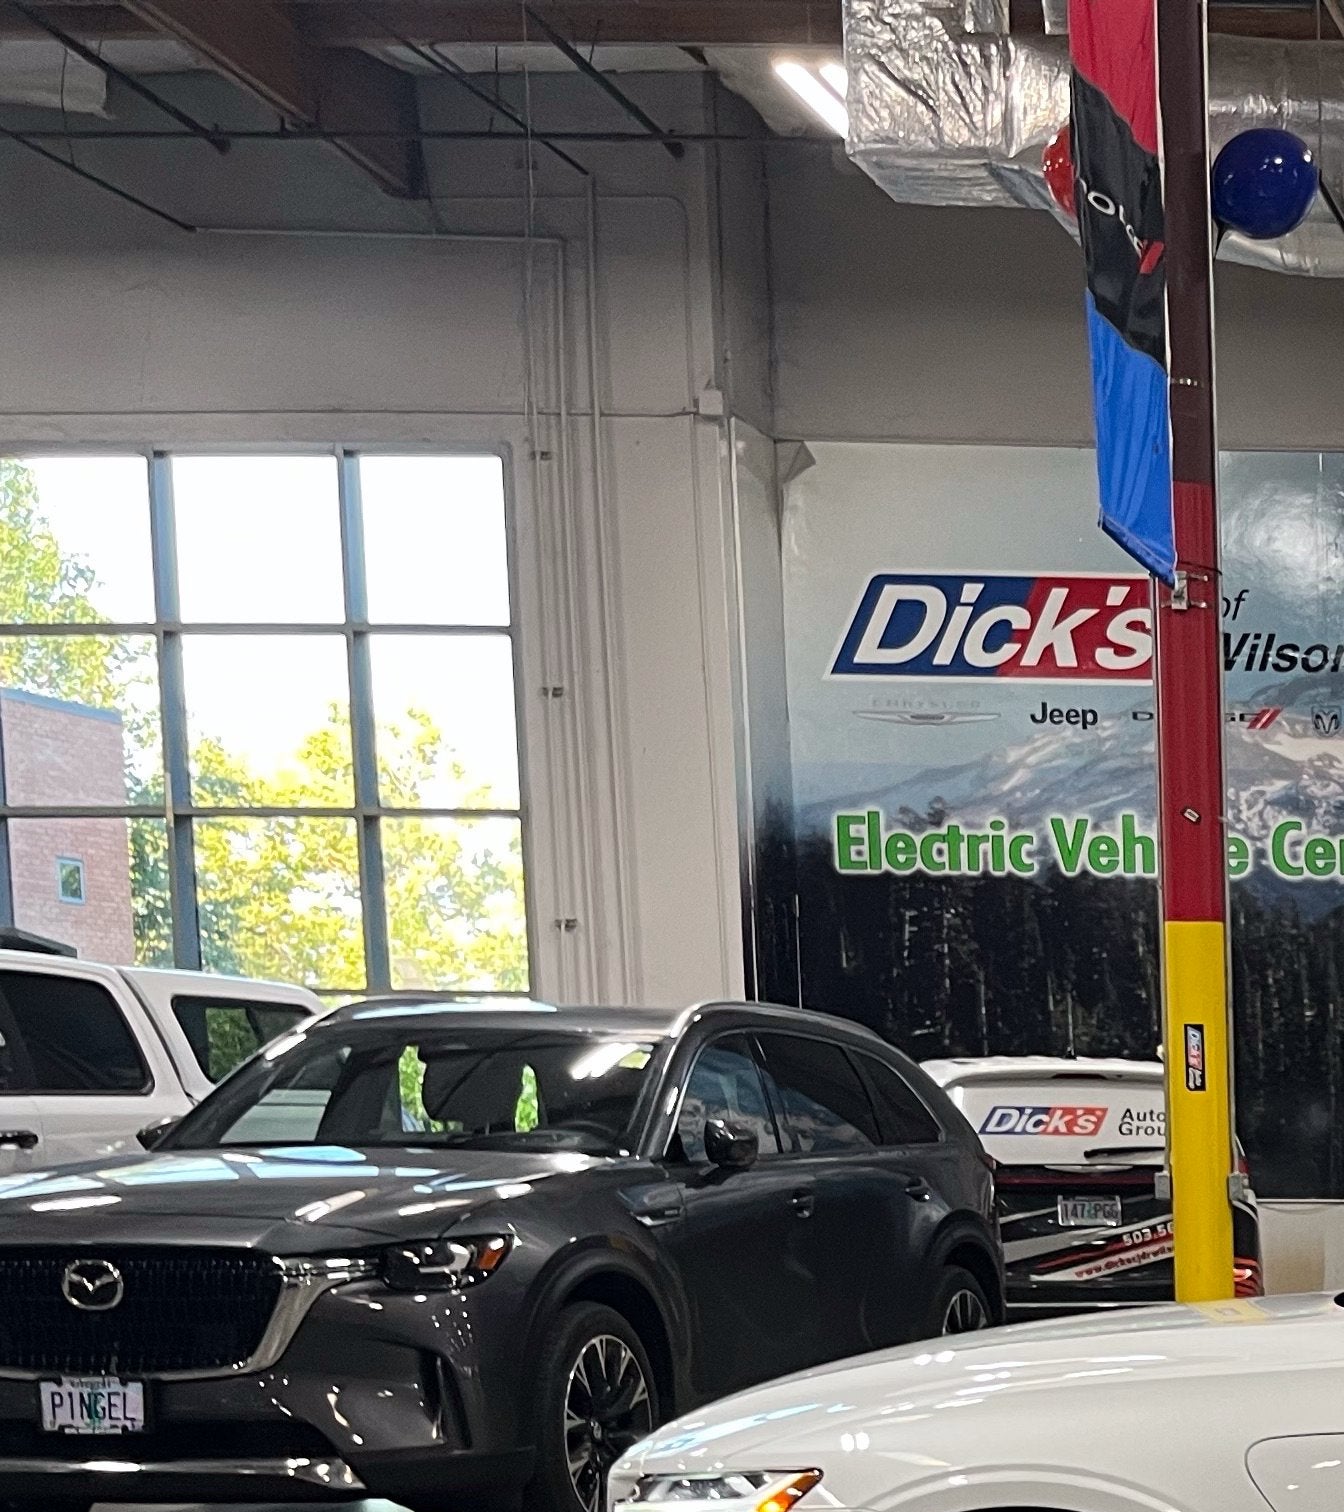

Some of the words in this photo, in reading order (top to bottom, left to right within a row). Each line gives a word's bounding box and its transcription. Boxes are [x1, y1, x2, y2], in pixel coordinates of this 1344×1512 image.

[853, 582, 1152, 670] Dick's
[1030, 702, 1099, 729] Jeep
[836, 811, 1037, 873] Electric
[1051, 814, 1250, 876] Vehe
[985, 1108, 1100, 1134] Dick's
[1118, 1122, 1165, 1136] Grou
[51, 1391, 137, 1422] PINGEL
